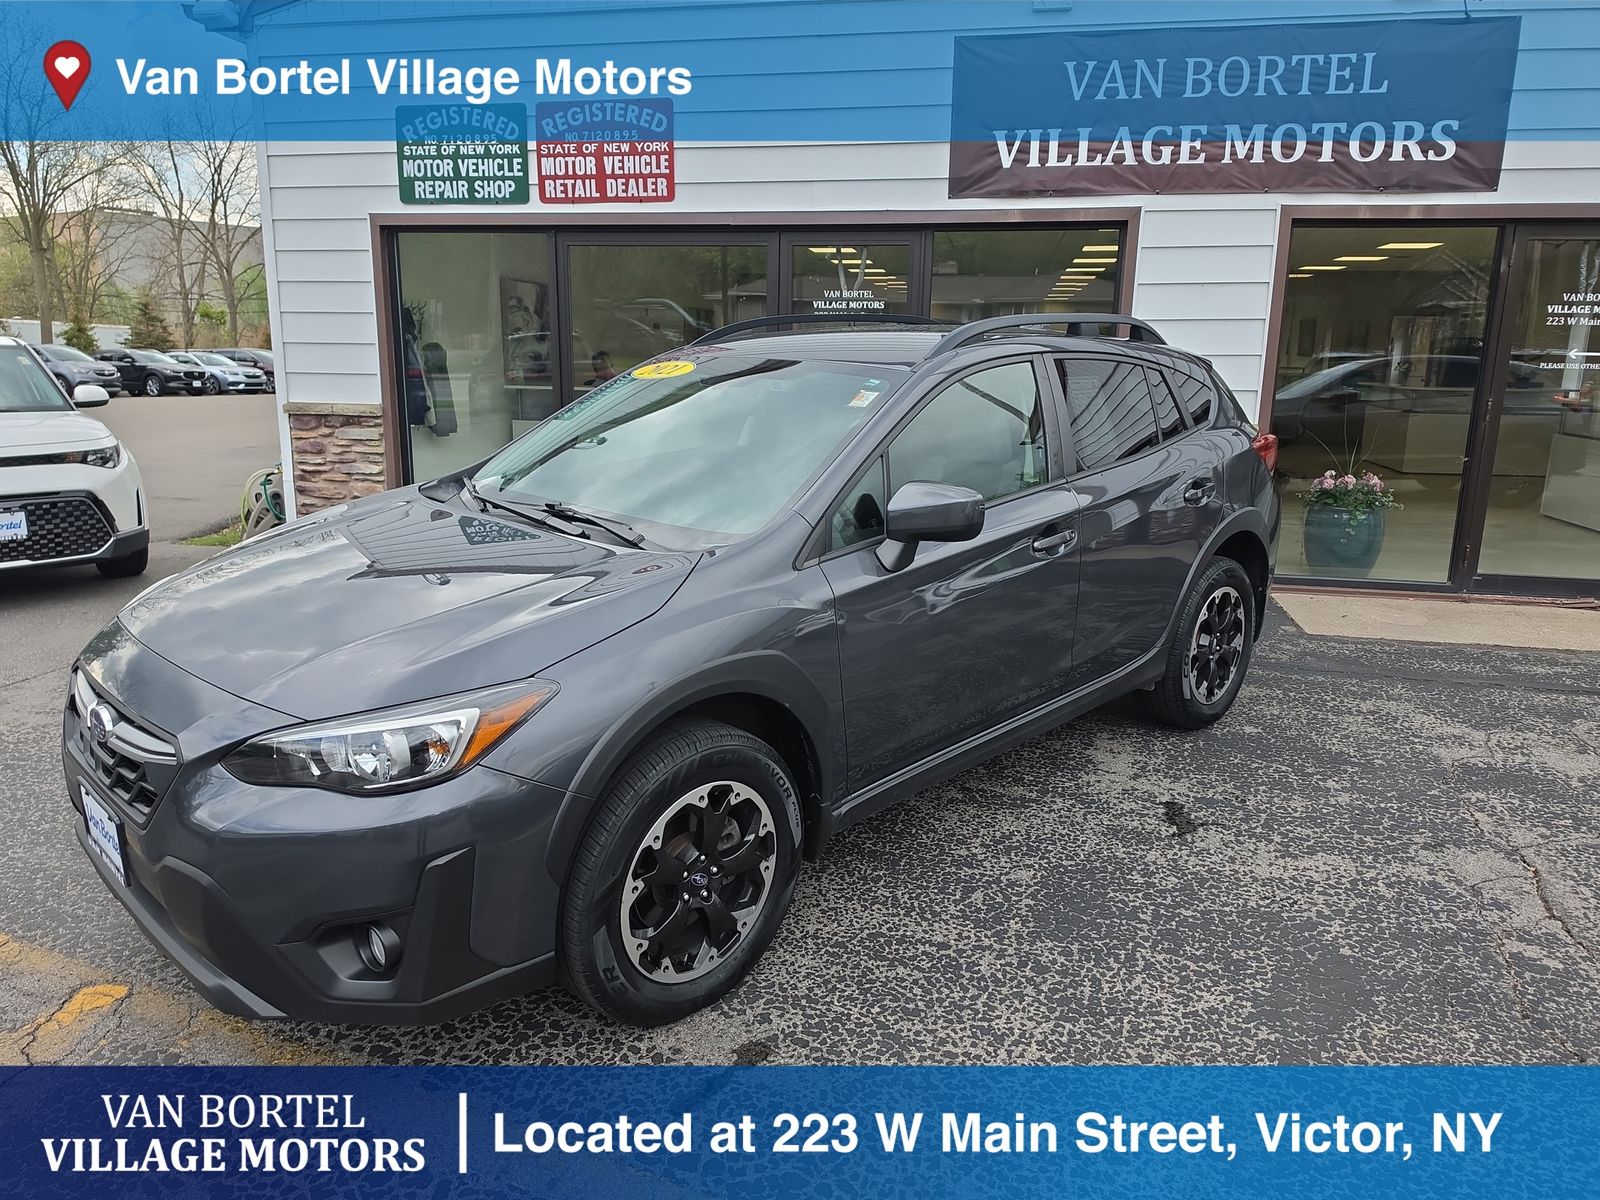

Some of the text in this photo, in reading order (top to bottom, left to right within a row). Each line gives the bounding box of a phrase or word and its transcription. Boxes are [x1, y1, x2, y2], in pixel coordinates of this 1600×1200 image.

[1063, 52, 1389, 100] VAN BORTEL
[401, 106, 519, 144] REGISTERED
[541, 102, 668, 137] REGISTERED
[442, 133, 498, 144] 7120895
[582, 129, 639, 141] 7120895
[403, 143, 521, 156] STATE OF NEW YORK
[540, 141, 670, 155] STATE OF NEW YORK
[992, 119, 1460, 169] VILLAGE MOTORS
[402, 157, 524, 178] MOTOR VEHICLE
[541, 154, 670, 176] MOTOR VEHICLE
[413, 179, 516, 199] REPAIR SHOP
[544, 177, 668, 198] RETAIL DEALER
[823, 290, 874, 298] VAN BORTEL
[1563, 292, 1585, 302] VAN
[812, 301, 885, 309] VILLAGE MOTORS
[1547, 304, 1592, 314] VILLAGE
[1546, 316, 1565, 326] 223
[1567, 317, 1578, 326] W
[1540, 362, 1566, 370] PLEASE
